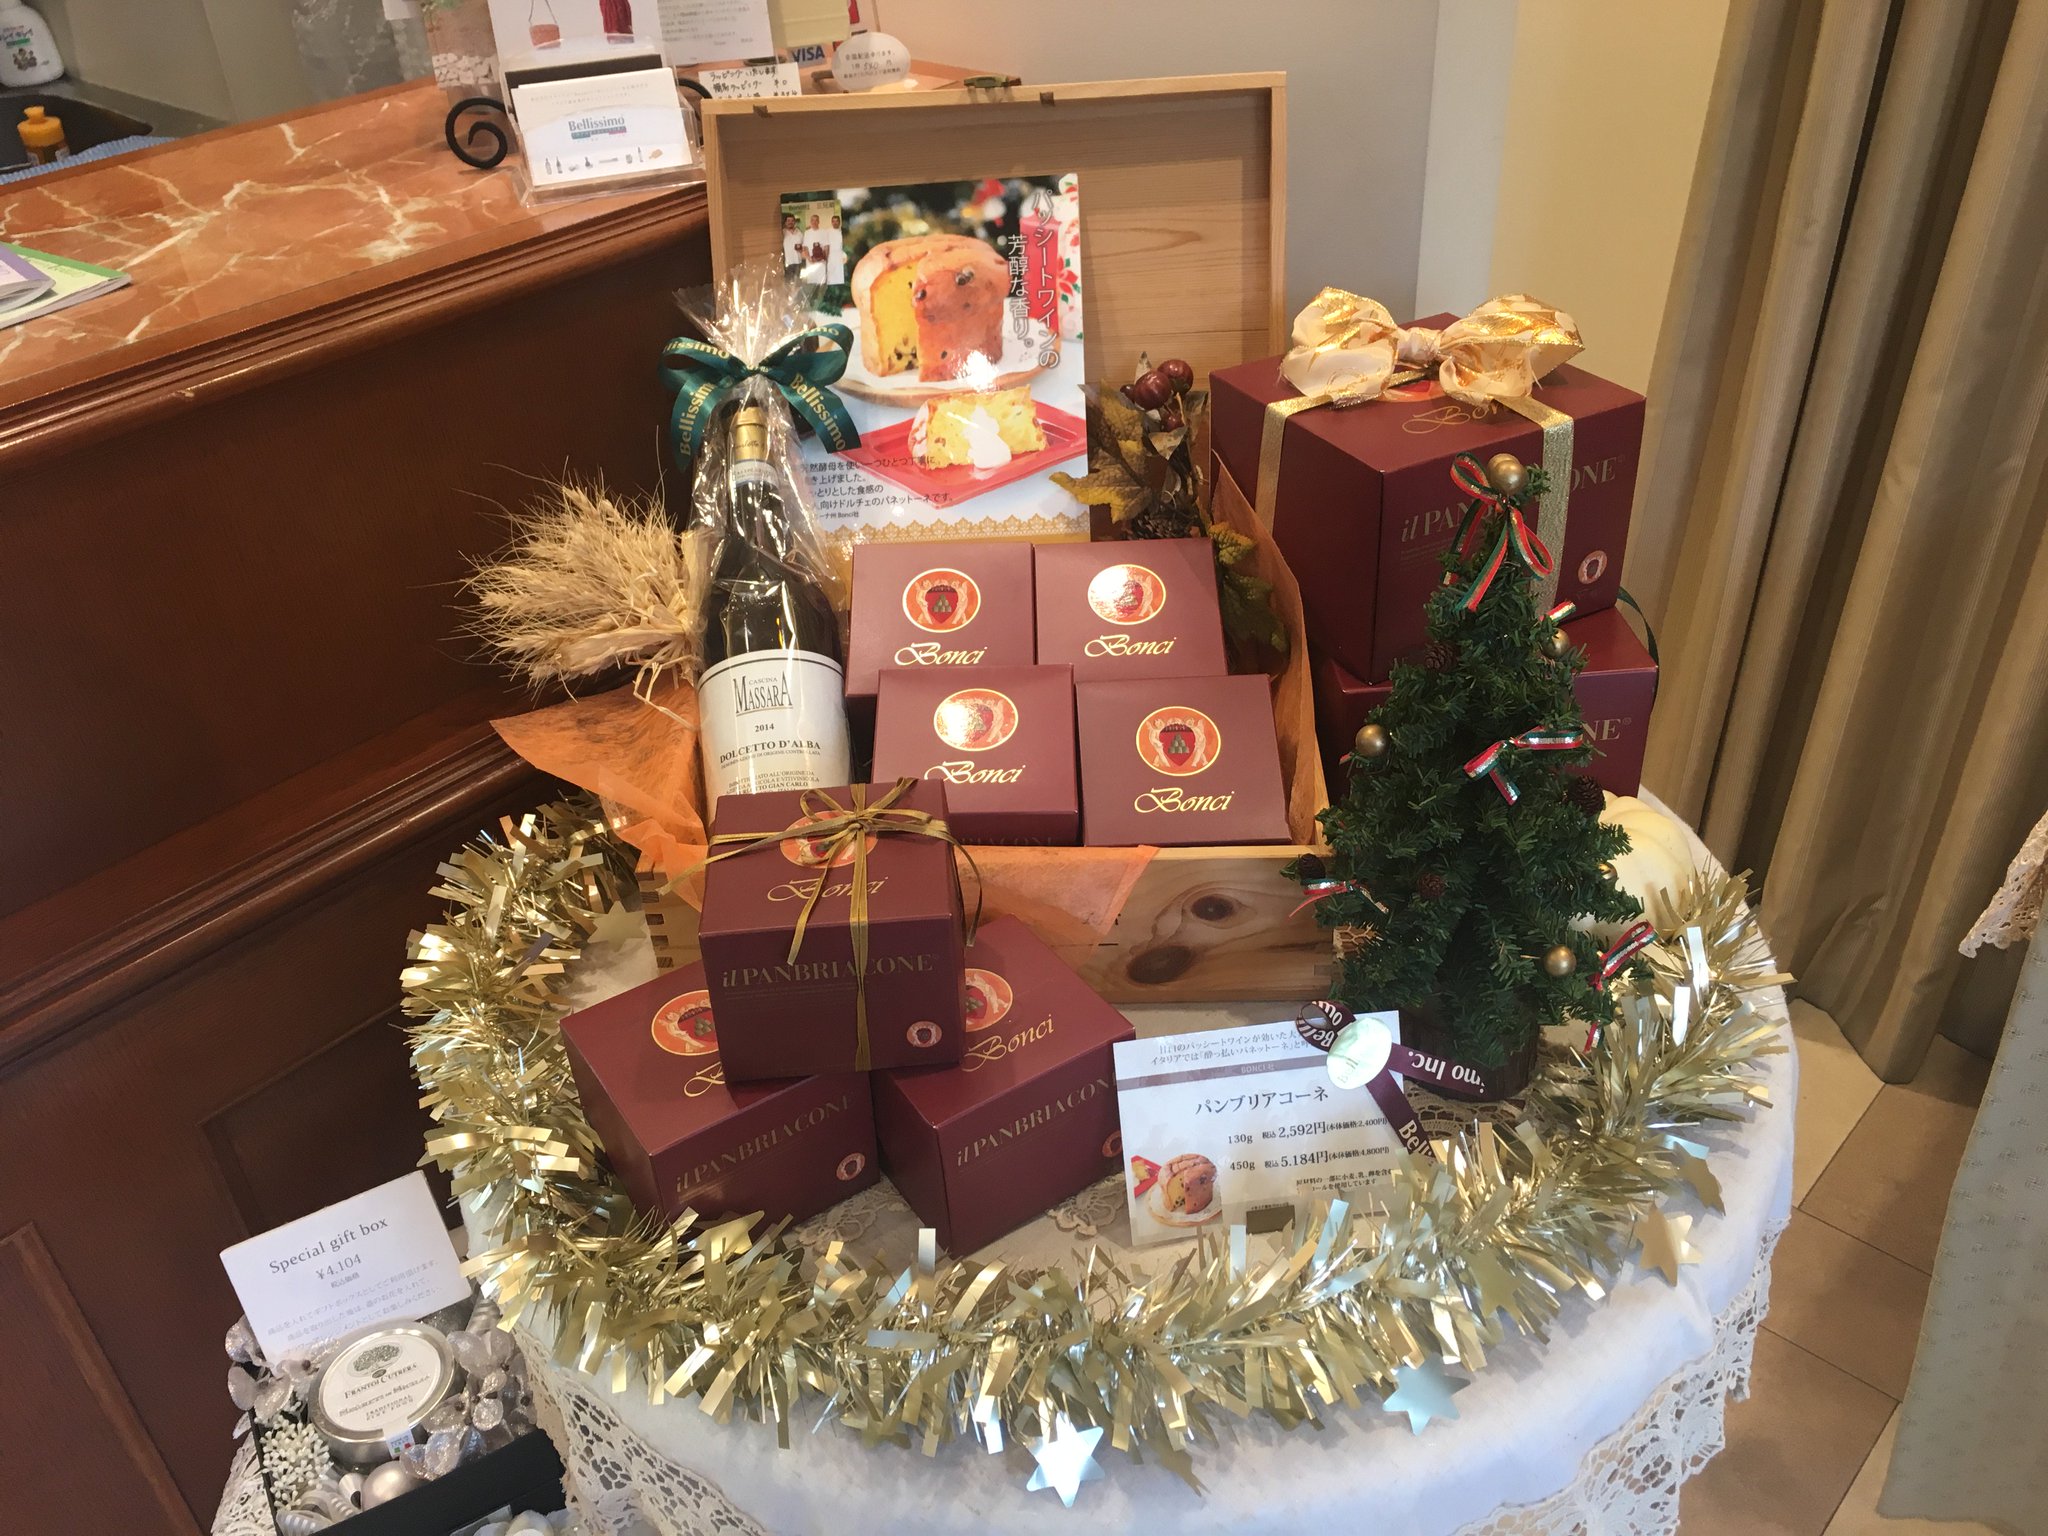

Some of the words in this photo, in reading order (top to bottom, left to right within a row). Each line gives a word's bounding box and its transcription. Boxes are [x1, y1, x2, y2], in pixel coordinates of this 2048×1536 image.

[792, 45, 826, 62] VISA
[568, 116, 626, 132] Bellissimo
[1007, 233, 1034, 348] 芳醇な香り。
[1033, 188, 1060, 369] パッシートワインの
[663, 341, 731, 359] llissimo
[679, 383, 716, 456] Bellissim
[790, 373, 847, 451] Bellissimo
[894, 641, 988, 666] Bonci
[1084, 633, 1177, 657] Bonci
[749, 677, 777, 685] CASCINA
[755, 723, 774, 733] 2014
[720, 741, 776, 764] DOLCETTO
[924, 760, 1027, 784] Bonci
[1134, 787, 1235, 813] Bonci
[961, 1013, 1054, 1073] Bonci
[1408, 1050, 1447, 1081] Inc.
[1195, 1086, 1329, 1116] パンブリアコーネ
[1228, 1134, 1253, 1144] 130g
[1229, 1160, 1255, 1171] 450g
[269, 1241, 326, 1274] Special
[329, 1229, 357, 1253] gift
[359, 1218, 388, 1236] box
